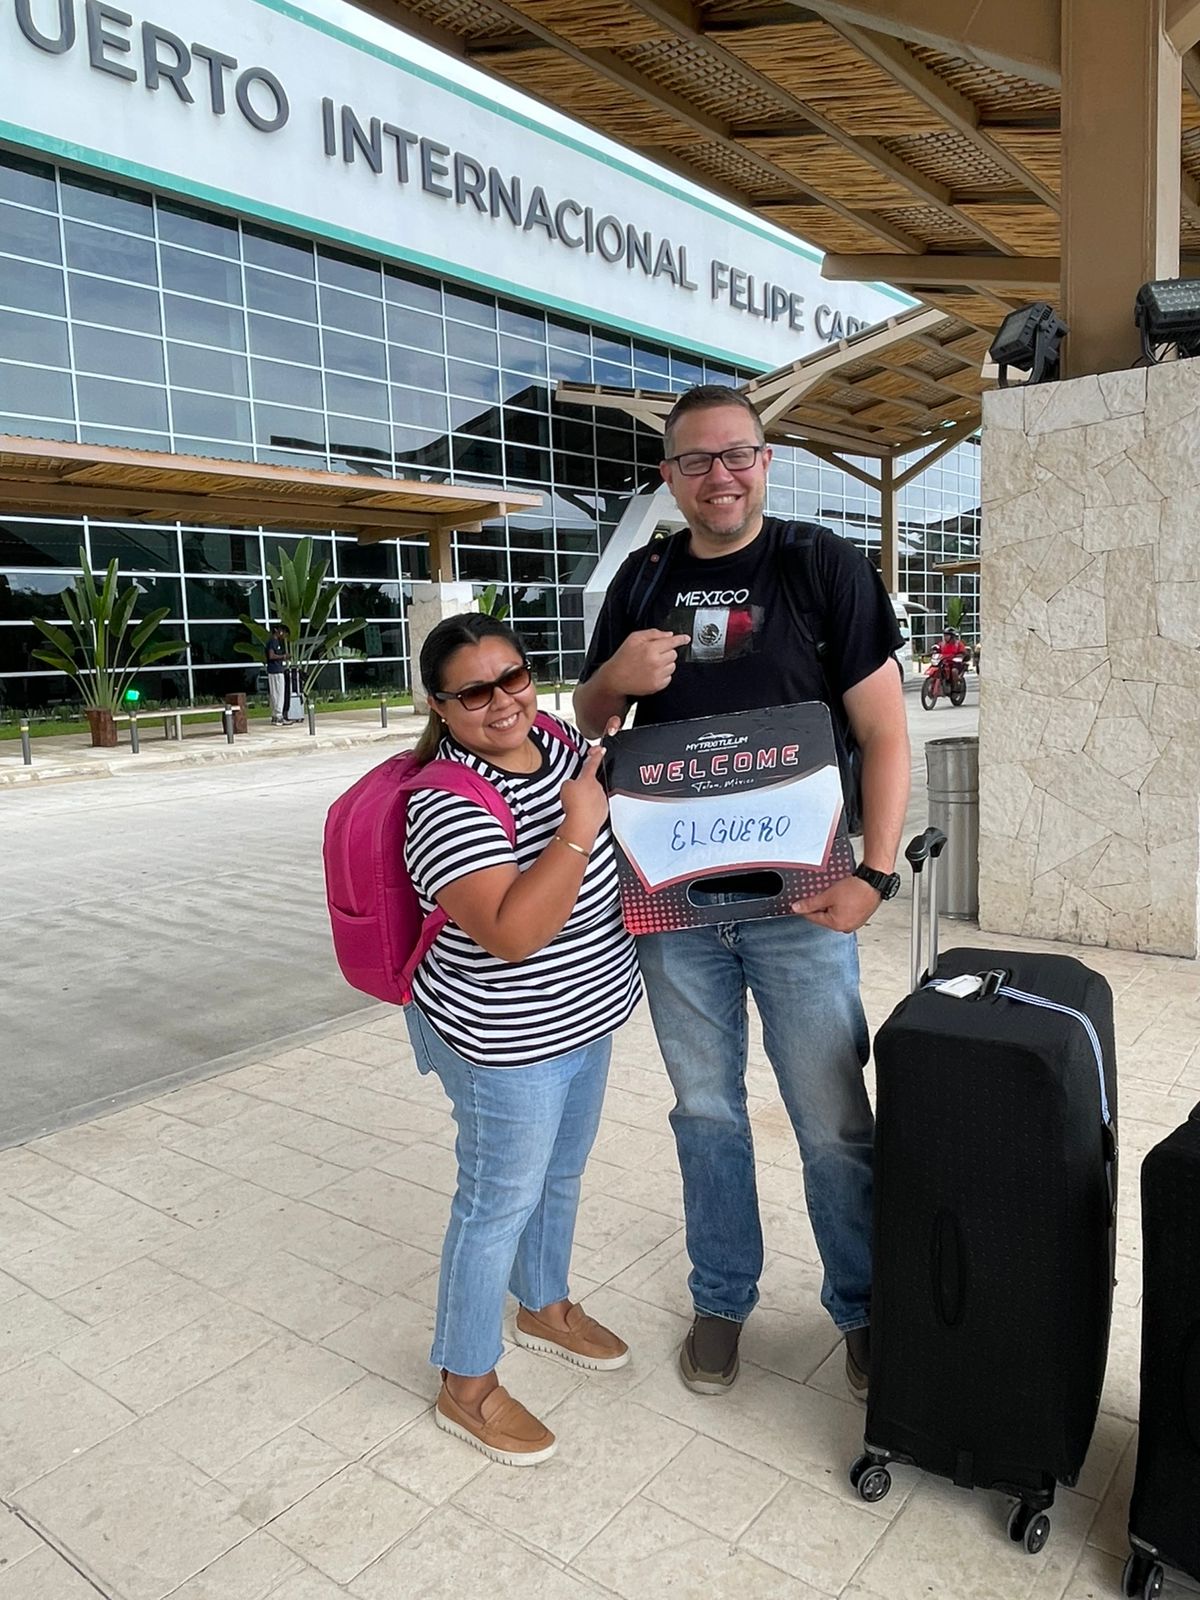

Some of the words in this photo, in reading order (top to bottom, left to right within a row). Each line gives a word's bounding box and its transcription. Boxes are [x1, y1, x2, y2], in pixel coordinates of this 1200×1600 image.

[321, 96, 699, 292] INTERNACIONAL
[711, 259, 805, 332] FELIPE
[675, 588, 750, 607] MEXICO
[639, 744, 800, 786] WELCOME
